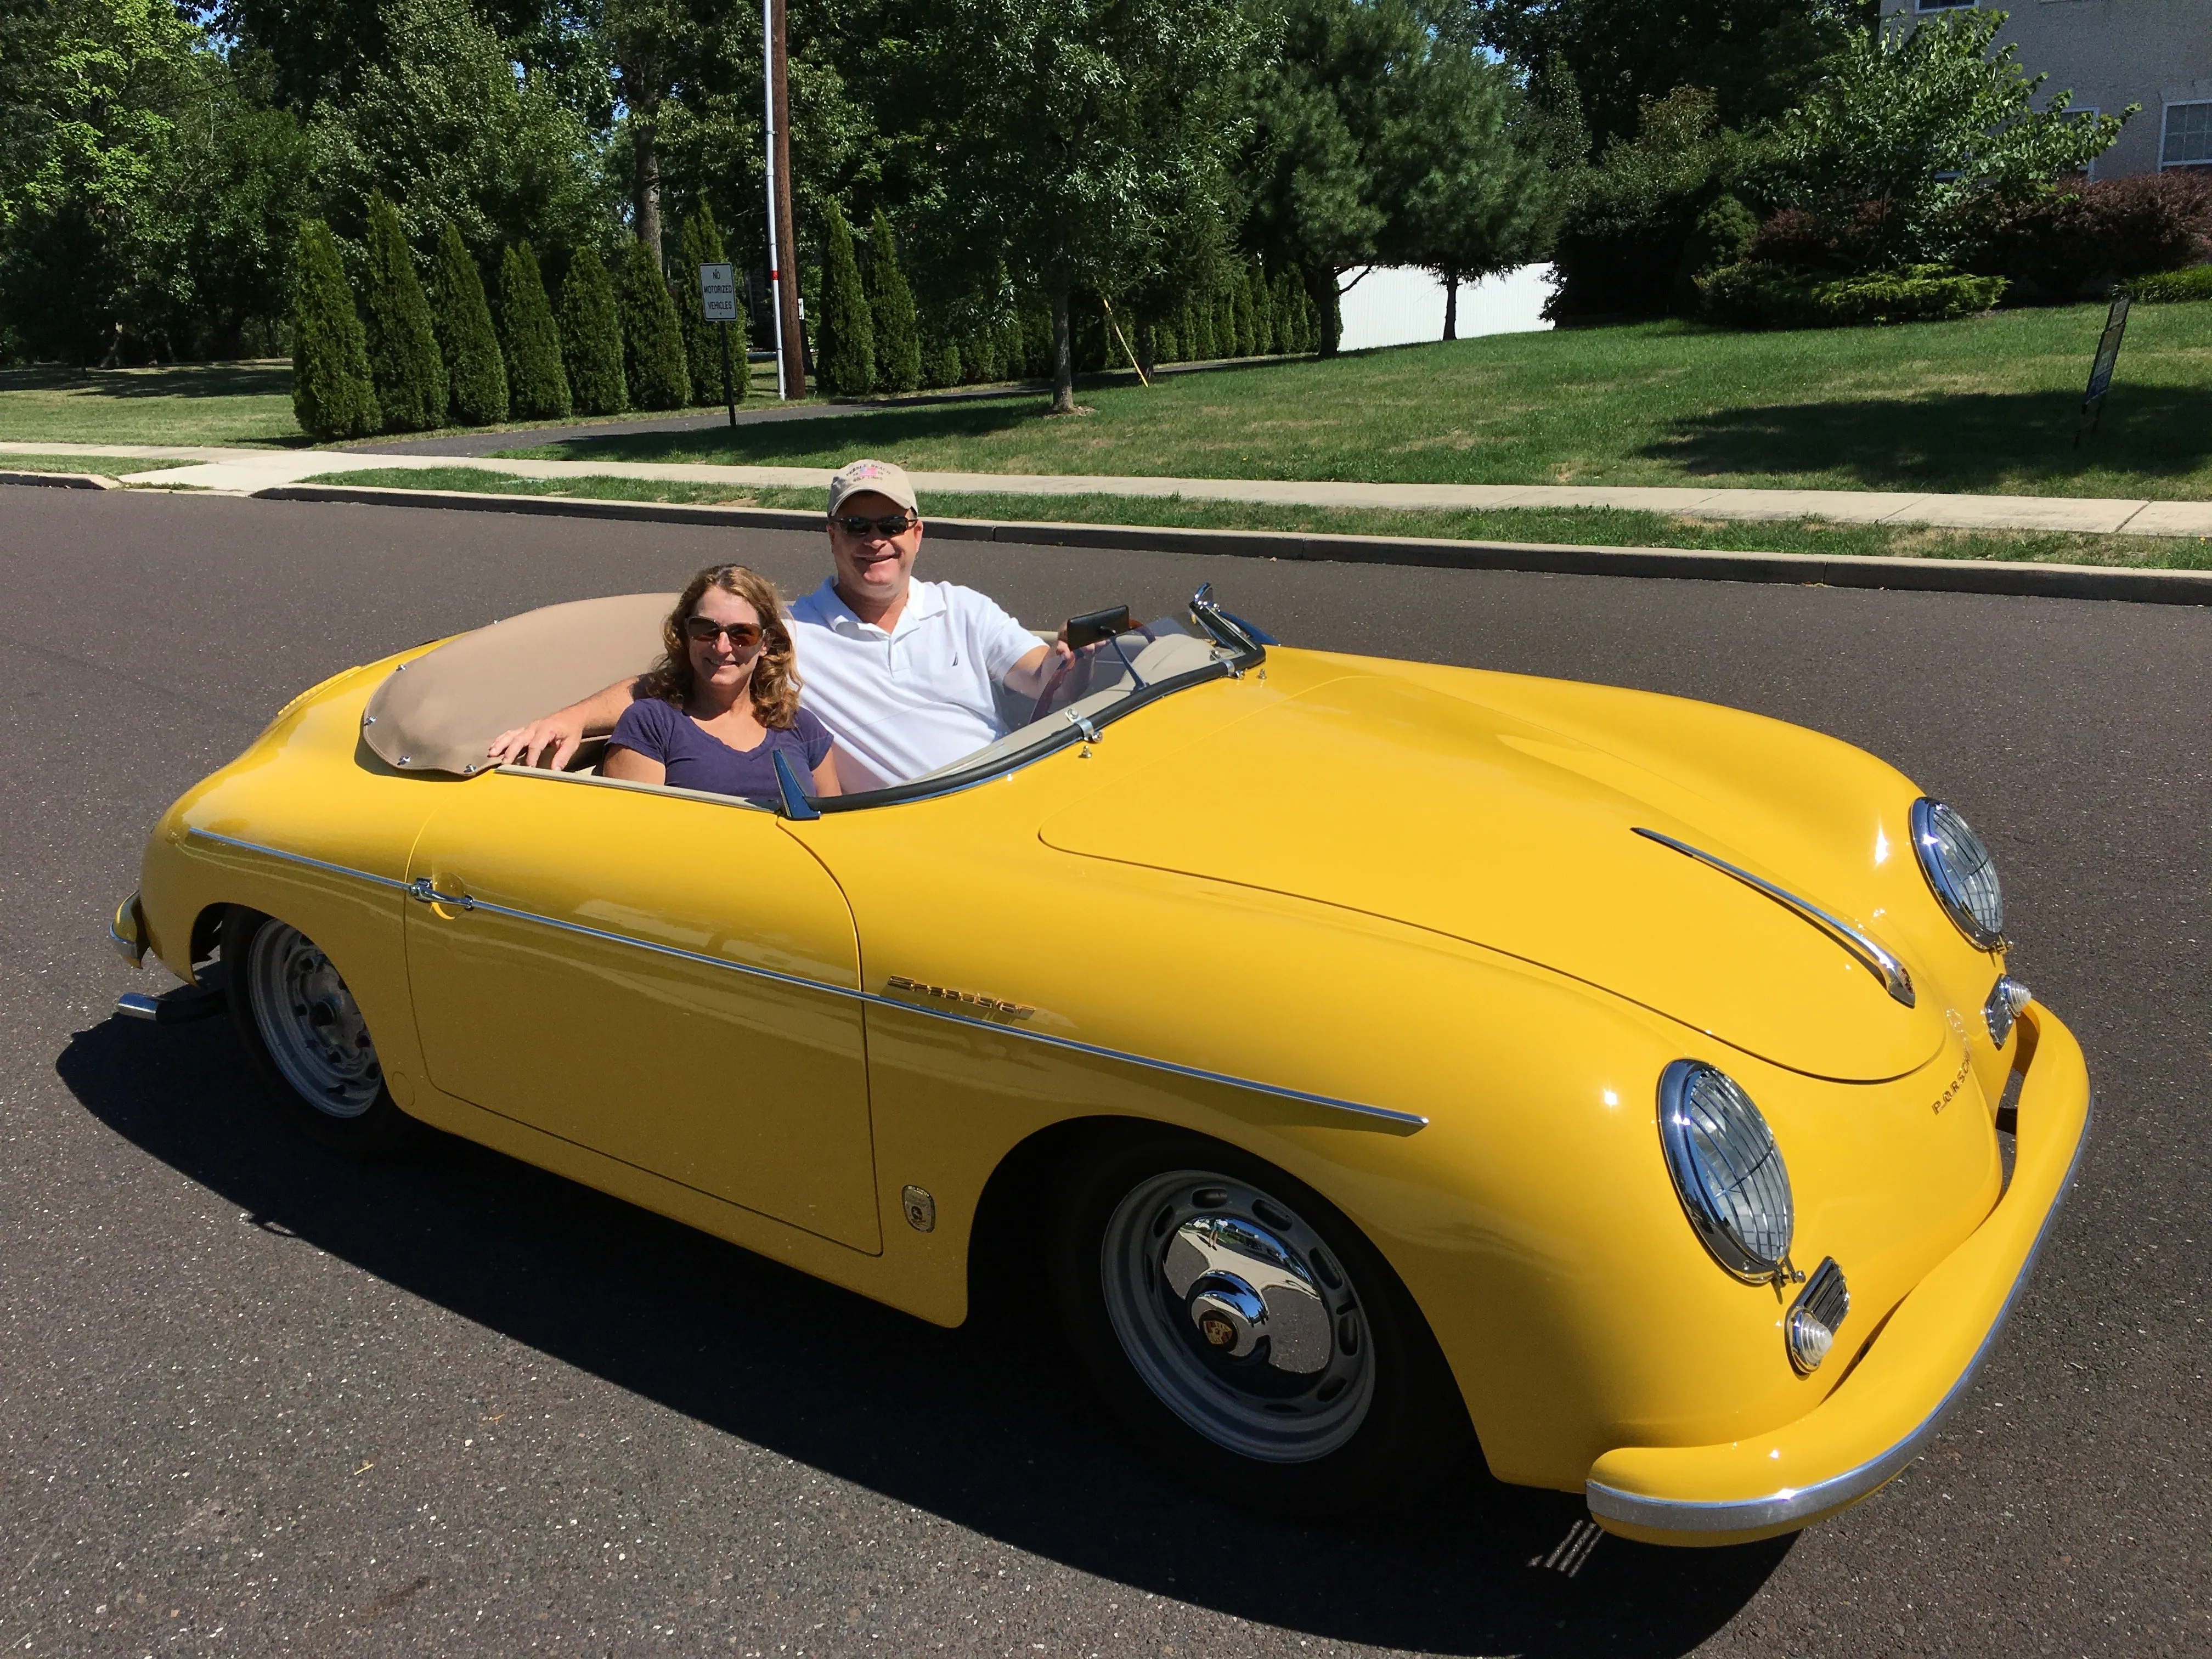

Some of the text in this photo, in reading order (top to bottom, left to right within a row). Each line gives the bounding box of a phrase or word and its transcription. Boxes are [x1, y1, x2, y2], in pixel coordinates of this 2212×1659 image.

[713, 270, 720, 279] NO
[703, 285, 732, 294] MOTORIZED
[707, 301, 732, 309] VEHICLES
[845, 464, 891, 476] PEBBLE BEACH
